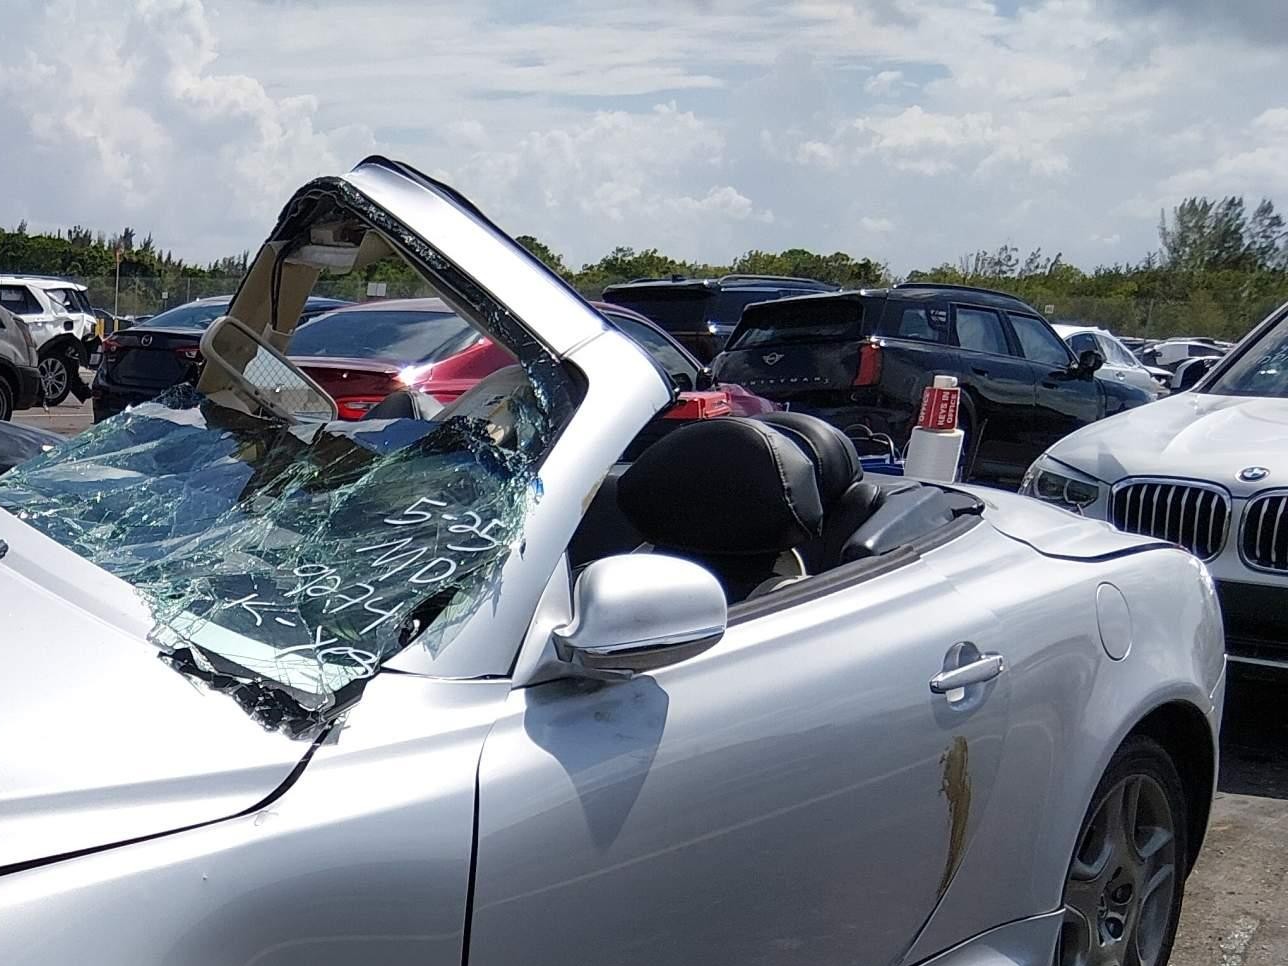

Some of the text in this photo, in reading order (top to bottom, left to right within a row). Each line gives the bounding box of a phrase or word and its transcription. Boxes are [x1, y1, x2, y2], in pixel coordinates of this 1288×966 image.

[937, 391, 951, 426] KEYS IN
[947, 393, 957, 424] OFFICE
[384, 497, 505, 551] 5-25
[283, 564, 405, 635] 9274
